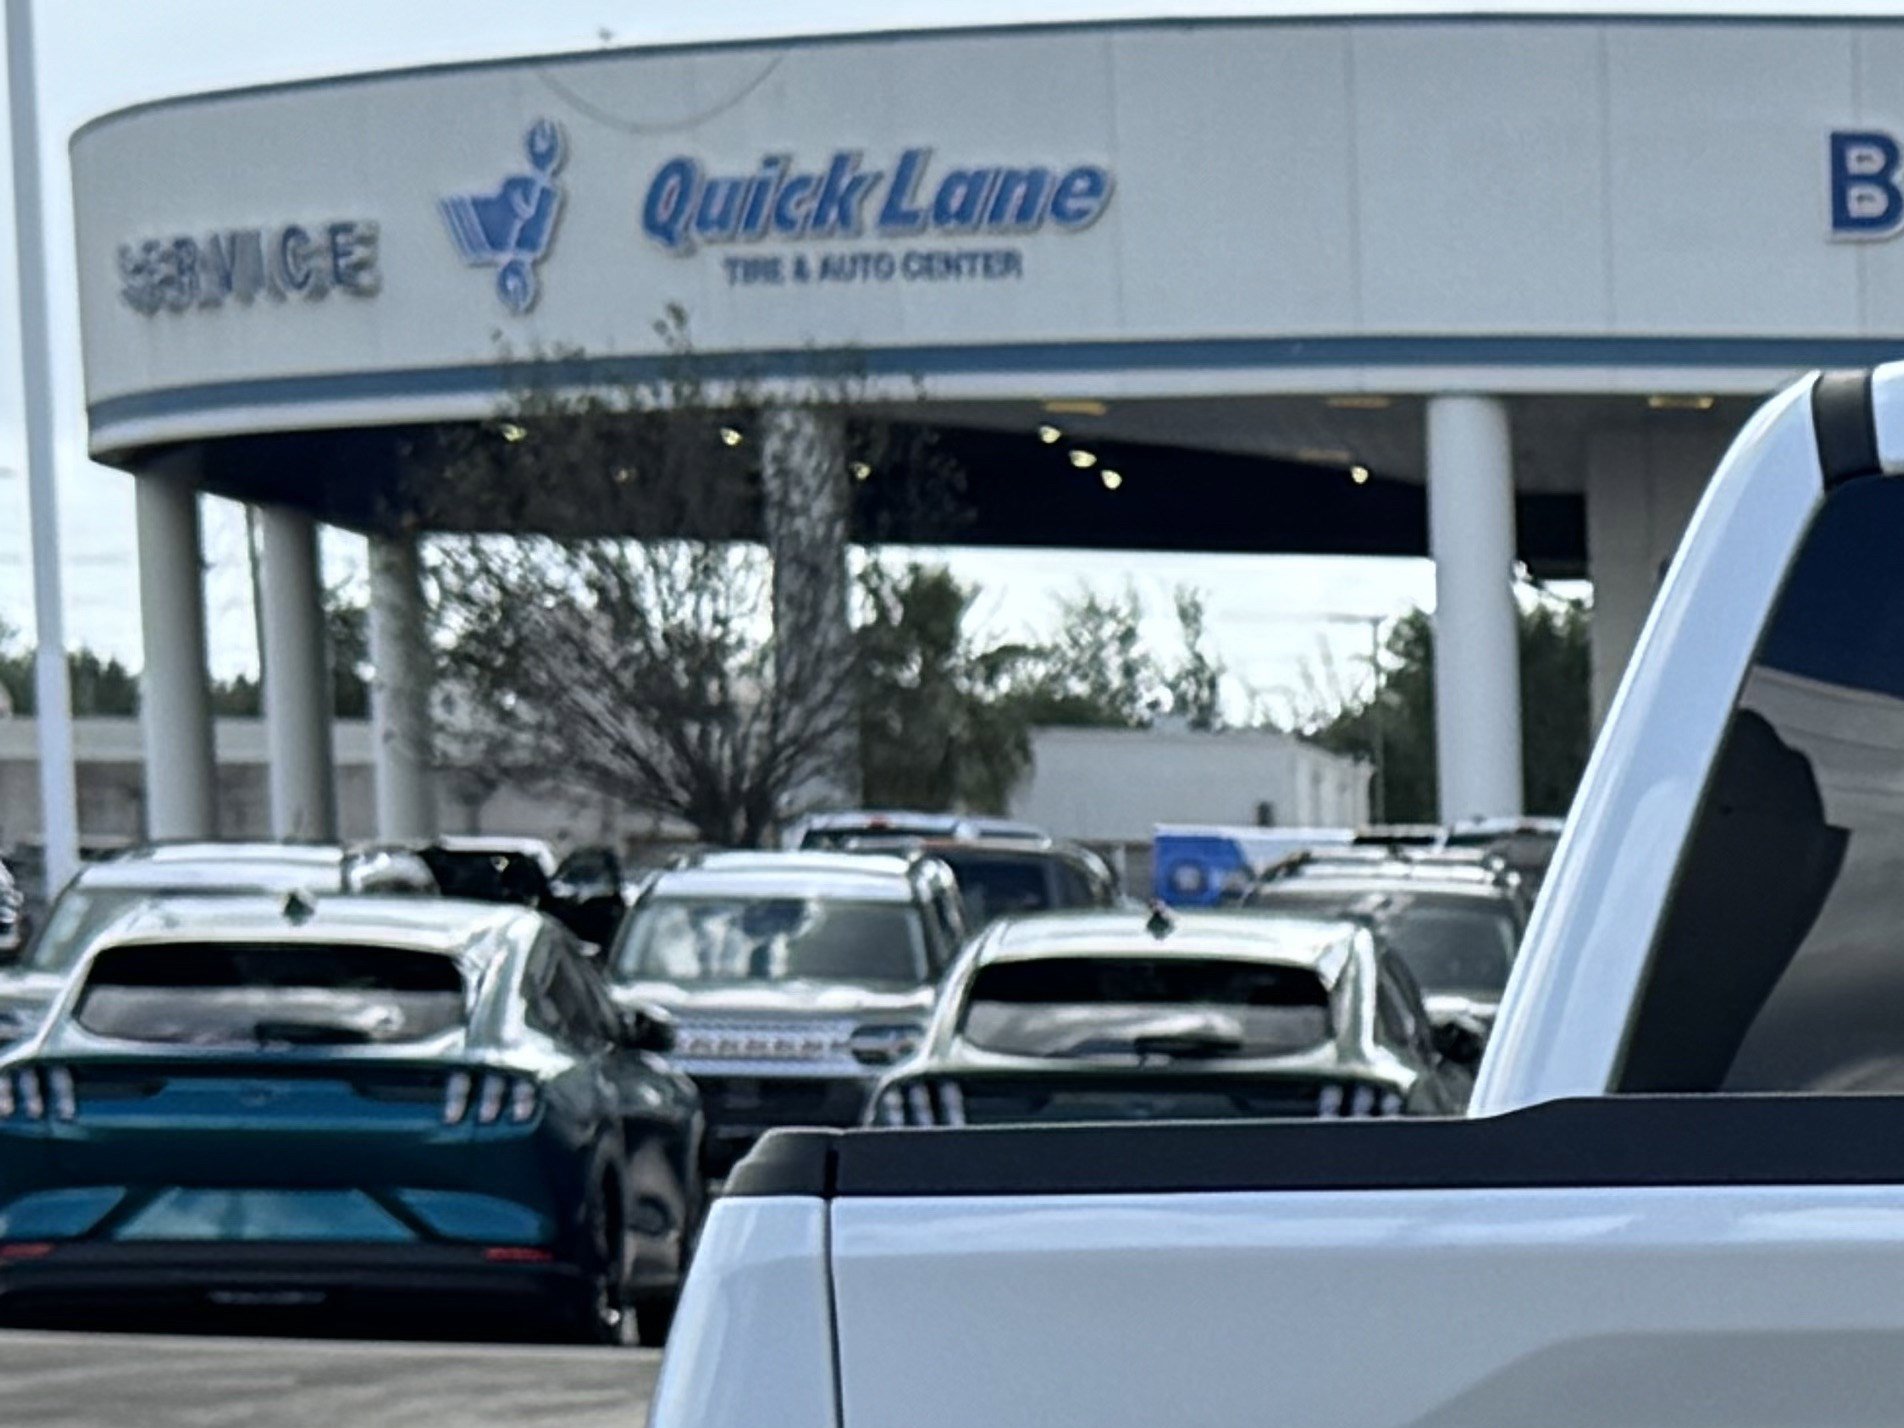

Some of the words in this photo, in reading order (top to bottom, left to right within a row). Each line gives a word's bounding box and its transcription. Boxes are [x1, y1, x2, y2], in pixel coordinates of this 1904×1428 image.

[641, 150, 880, 255] Quick
[876, 146, 1114, 235] Lane
[817, 252, 896, 282] AUTO
[901, 248, 1024, 281] CENTER
